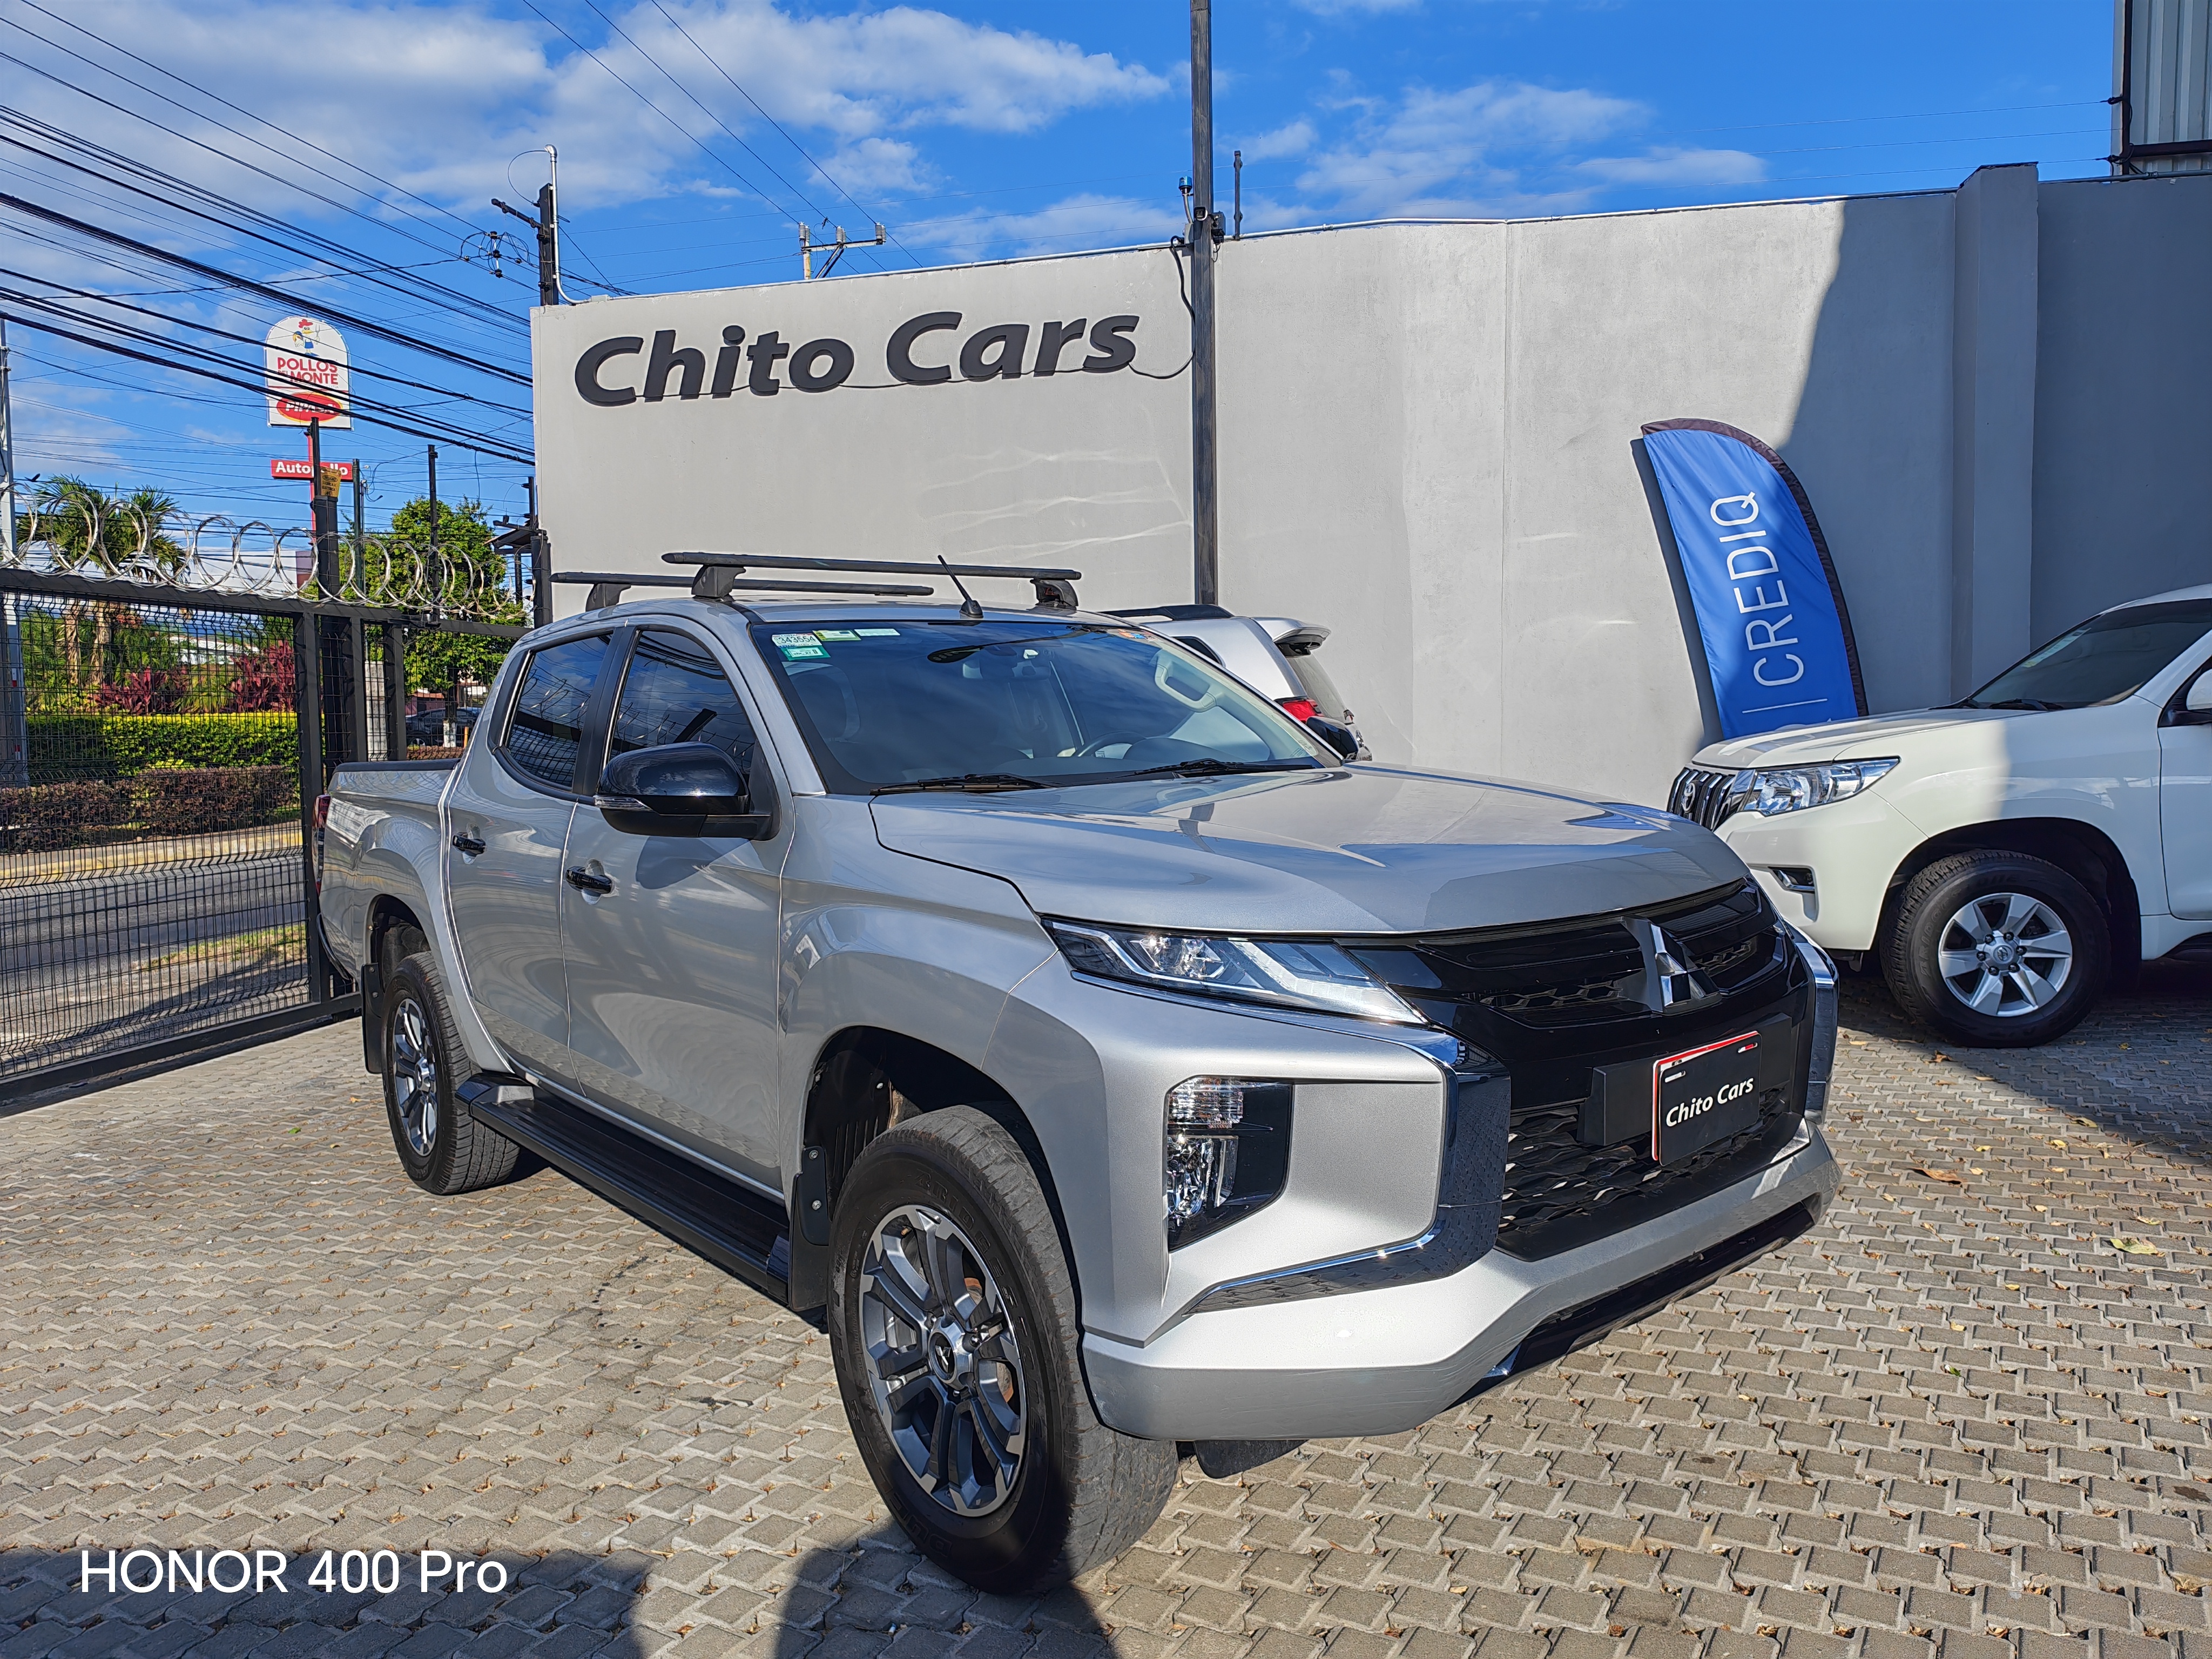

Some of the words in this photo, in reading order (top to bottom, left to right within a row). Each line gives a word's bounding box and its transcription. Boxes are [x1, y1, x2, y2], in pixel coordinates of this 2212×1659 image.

[278, 357, 338, 373] POLLOS
[575, 325, 854, 407] Chito
[886, 312, 1140, 385] Cars
[290, 371, 339, 385] MONTE
[275, 462, 348, 477] Autollo
[1710, 491, 1804, 687] CREDIQ
[778, 636, 816, 644] 343554
[1666, 1096, 1714, 1127] Chito
[1717, 1077, 1754, 1105] Cars
